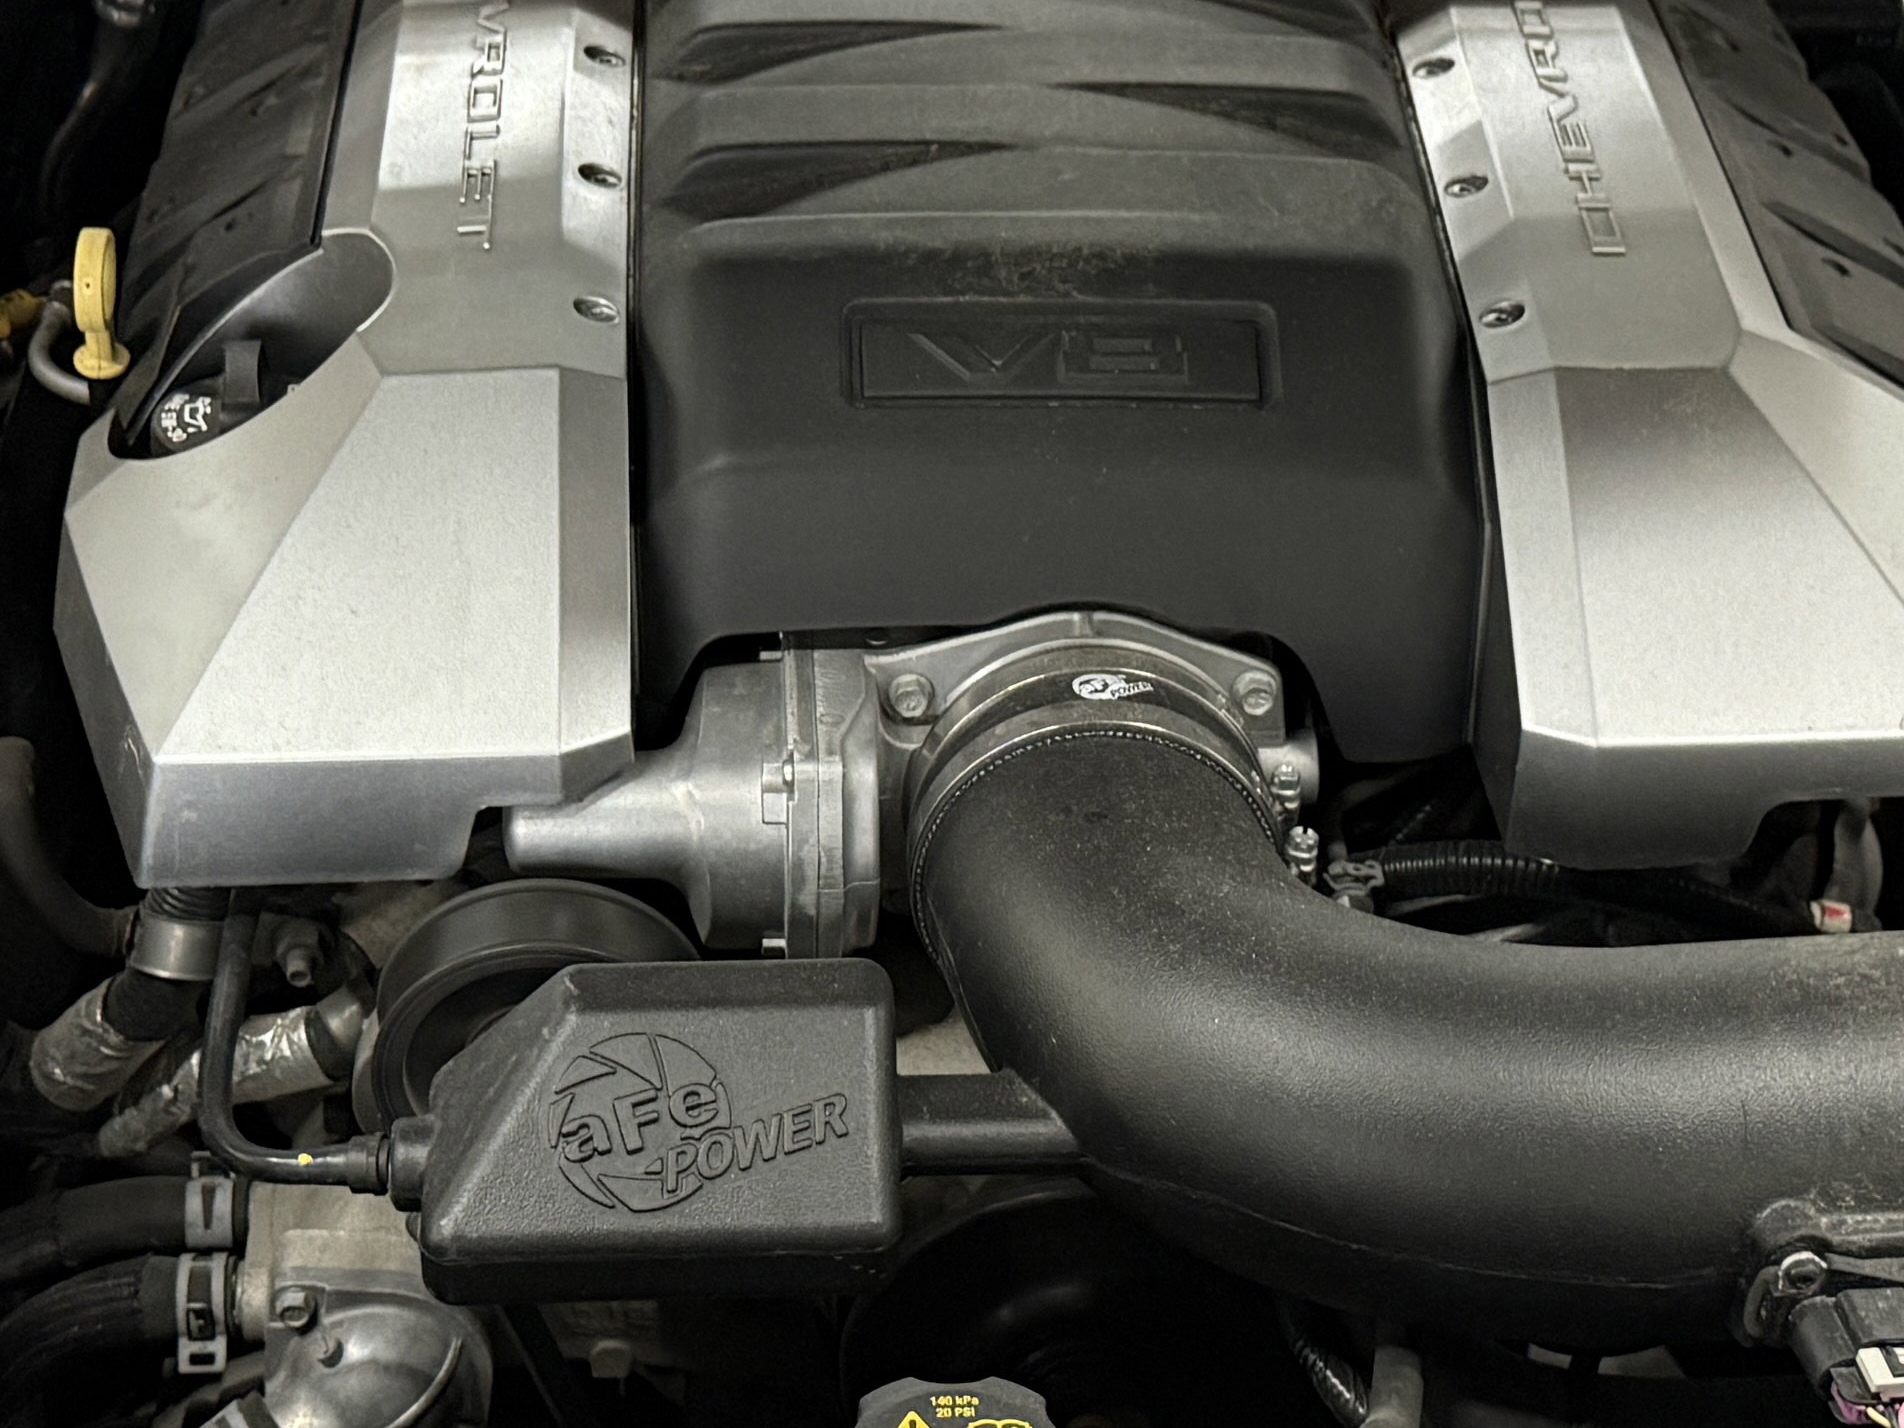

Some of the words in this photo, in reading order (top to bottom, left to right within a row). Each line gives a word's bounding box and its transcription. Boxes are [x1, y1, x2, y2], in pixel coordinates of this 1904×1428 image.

[904, 328, 1190, 387] V8
[560, 1080, 719, 1164] aFe
[662, 1093, 850, 1194] POWER
[935, 1407, 952, 1418] 20
[954, 1406, 976, 1418] PSI
[955, 1395, 980, 1407] kPa
